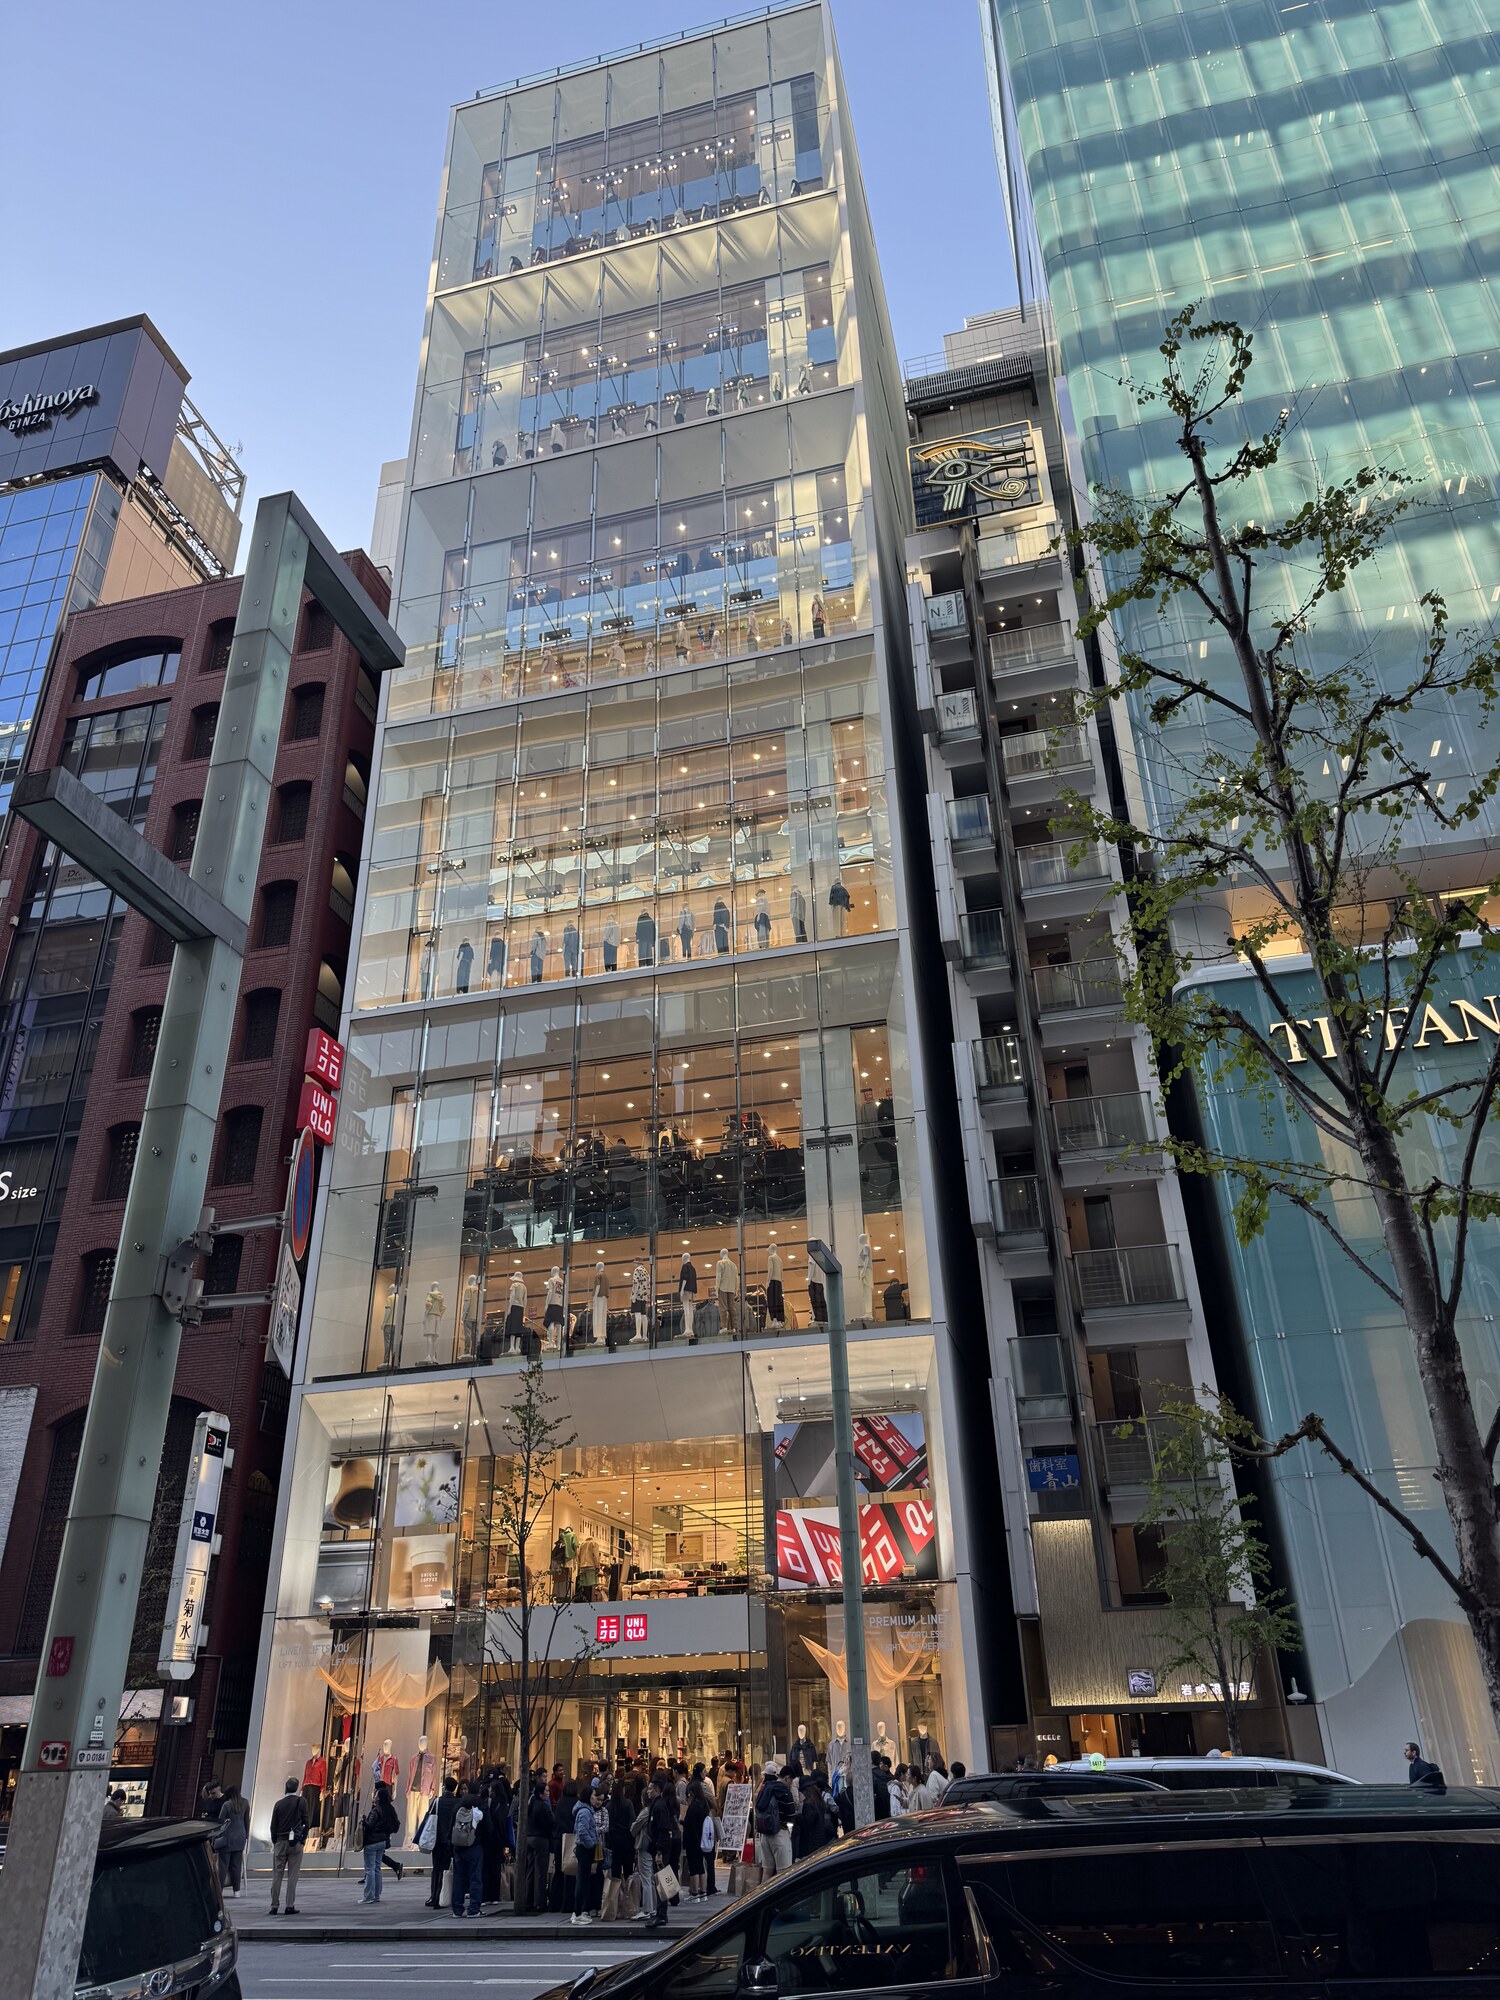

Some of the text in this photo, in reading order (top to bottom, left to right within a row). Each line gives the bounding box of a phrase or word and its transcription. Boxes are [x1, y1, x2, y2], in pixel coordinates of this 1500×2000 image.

[8, 412, 45, 430] GINZA
[1269, 995, 1500, 1063] TIFAN
[320, 1036, 340, 1064] ユニ
[317, 1054, 339, 1081] クロ
[38, 1070, 65, 1083] size
[312, 1089, 333, 1117] UNI
[310, 1109, 332, 1136] QLO
[10, 1187, 38, 1200] size
[1028, 1458, 1068, 1473] 歯科室
[1042, 1471, 1079, 1490] 青山
[179, 1598, 196, 1641] 菊水
[600, 1619, 617, 1629] ユニ
[626, 1617, 644, 1628] UNI
[869, 1612, 949, 1627] PREMIUM LINE
[599, 1629, 617, 1640] クロ
[626, 1628, 645, 1640] QLO
[334, 1642, 350, 1653] YOU
[86, 1752, 105, 1761] D 0184
